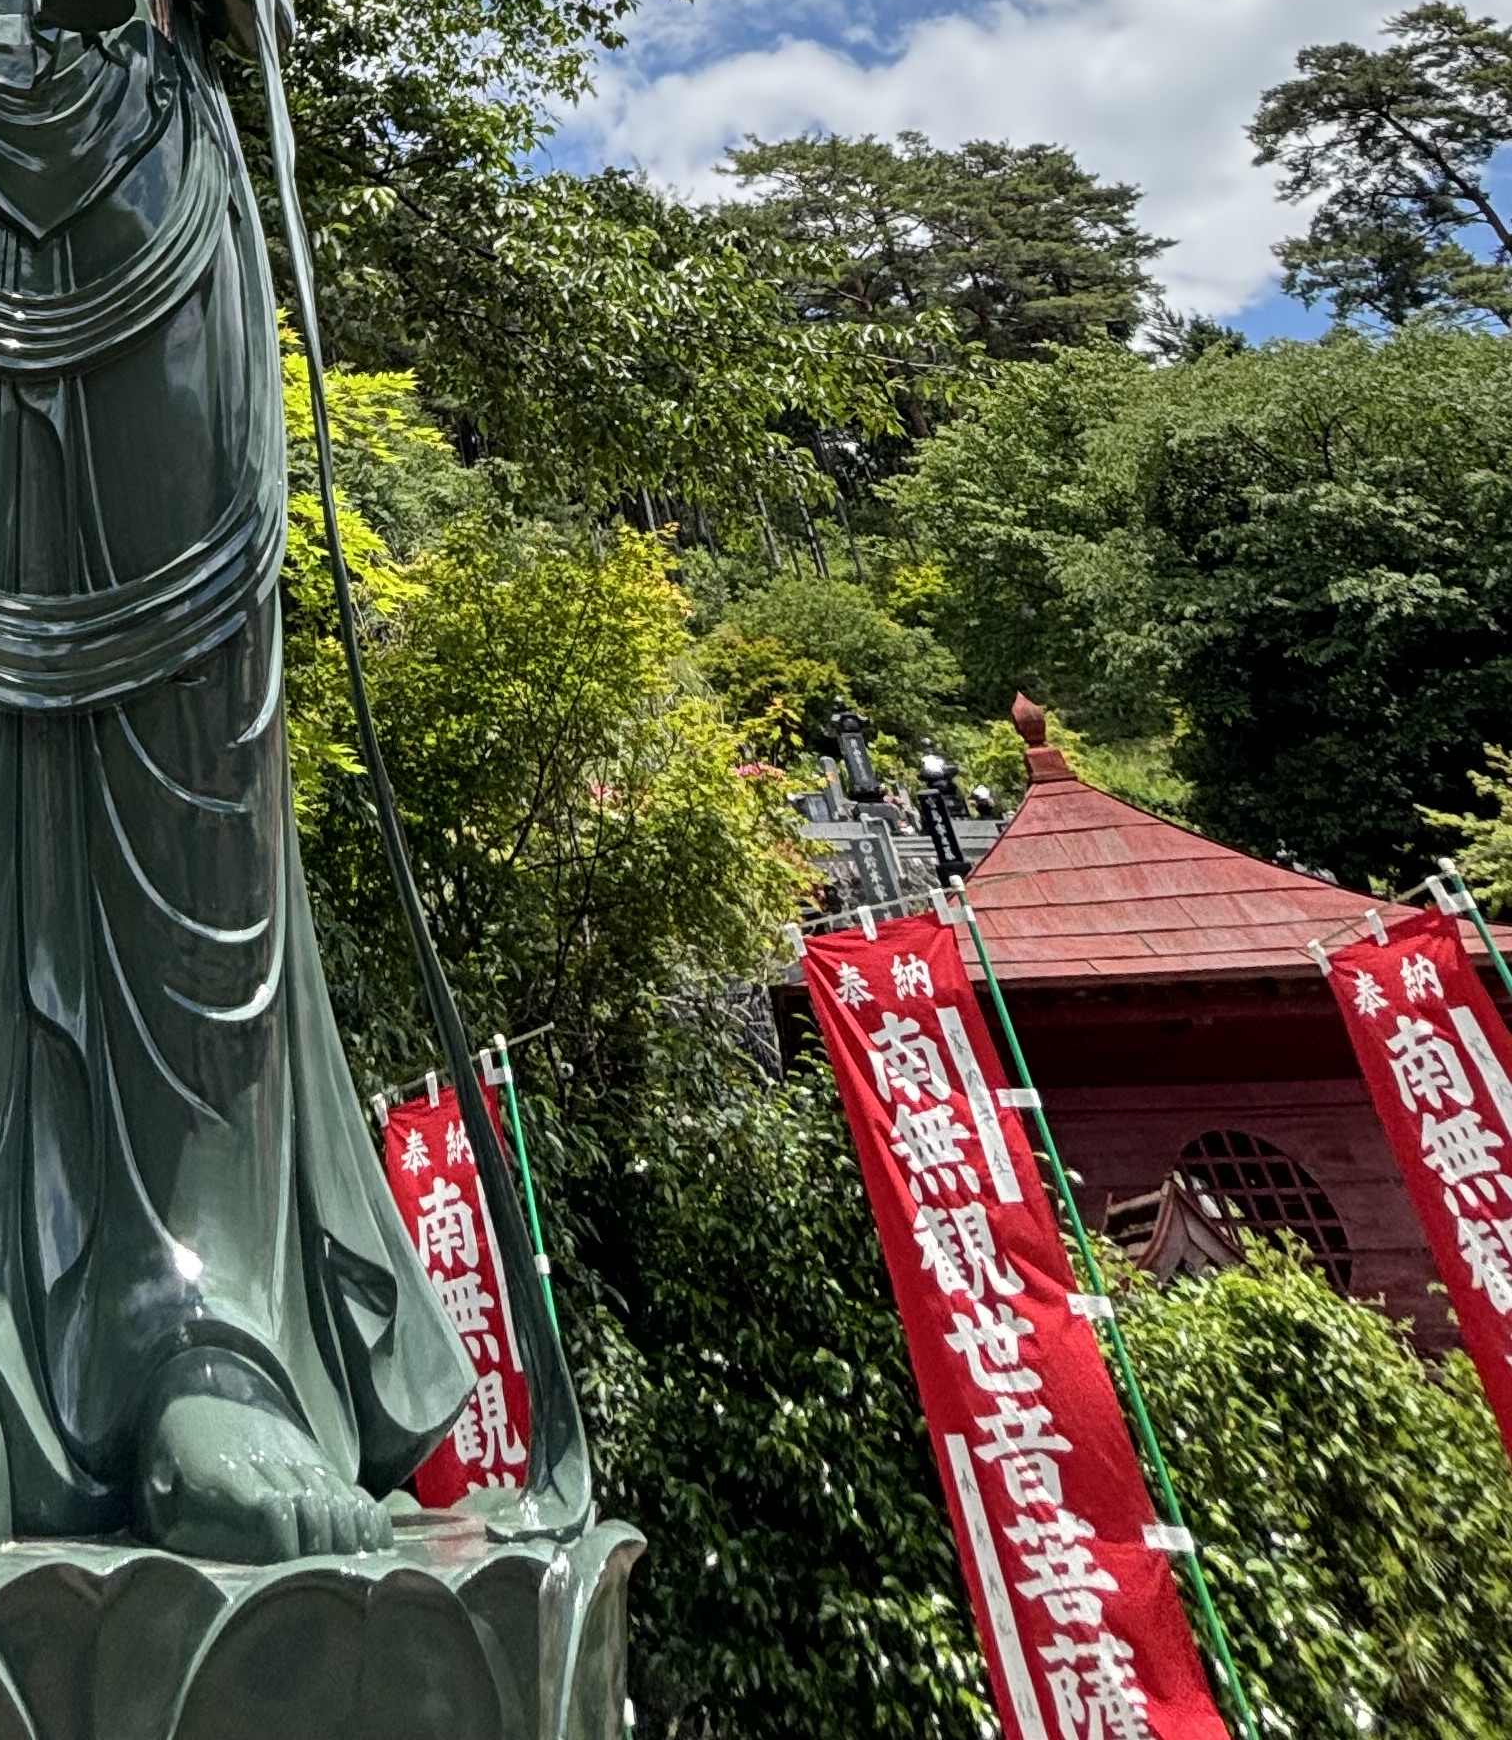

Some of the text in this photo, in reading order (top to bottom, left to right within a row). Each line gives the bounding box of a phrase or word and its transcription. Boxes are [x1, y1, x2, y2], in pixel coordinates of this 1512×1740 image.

[836, 953, 934, 1010] 奉納
[1354, 953, 1444, 1017] 奉納
[401, 1120, 475, 1176] 奉納
[417, 1176, 527, 1495] 南無観
[868, 1012, 1158, 1740] 南無観世音菩薩
